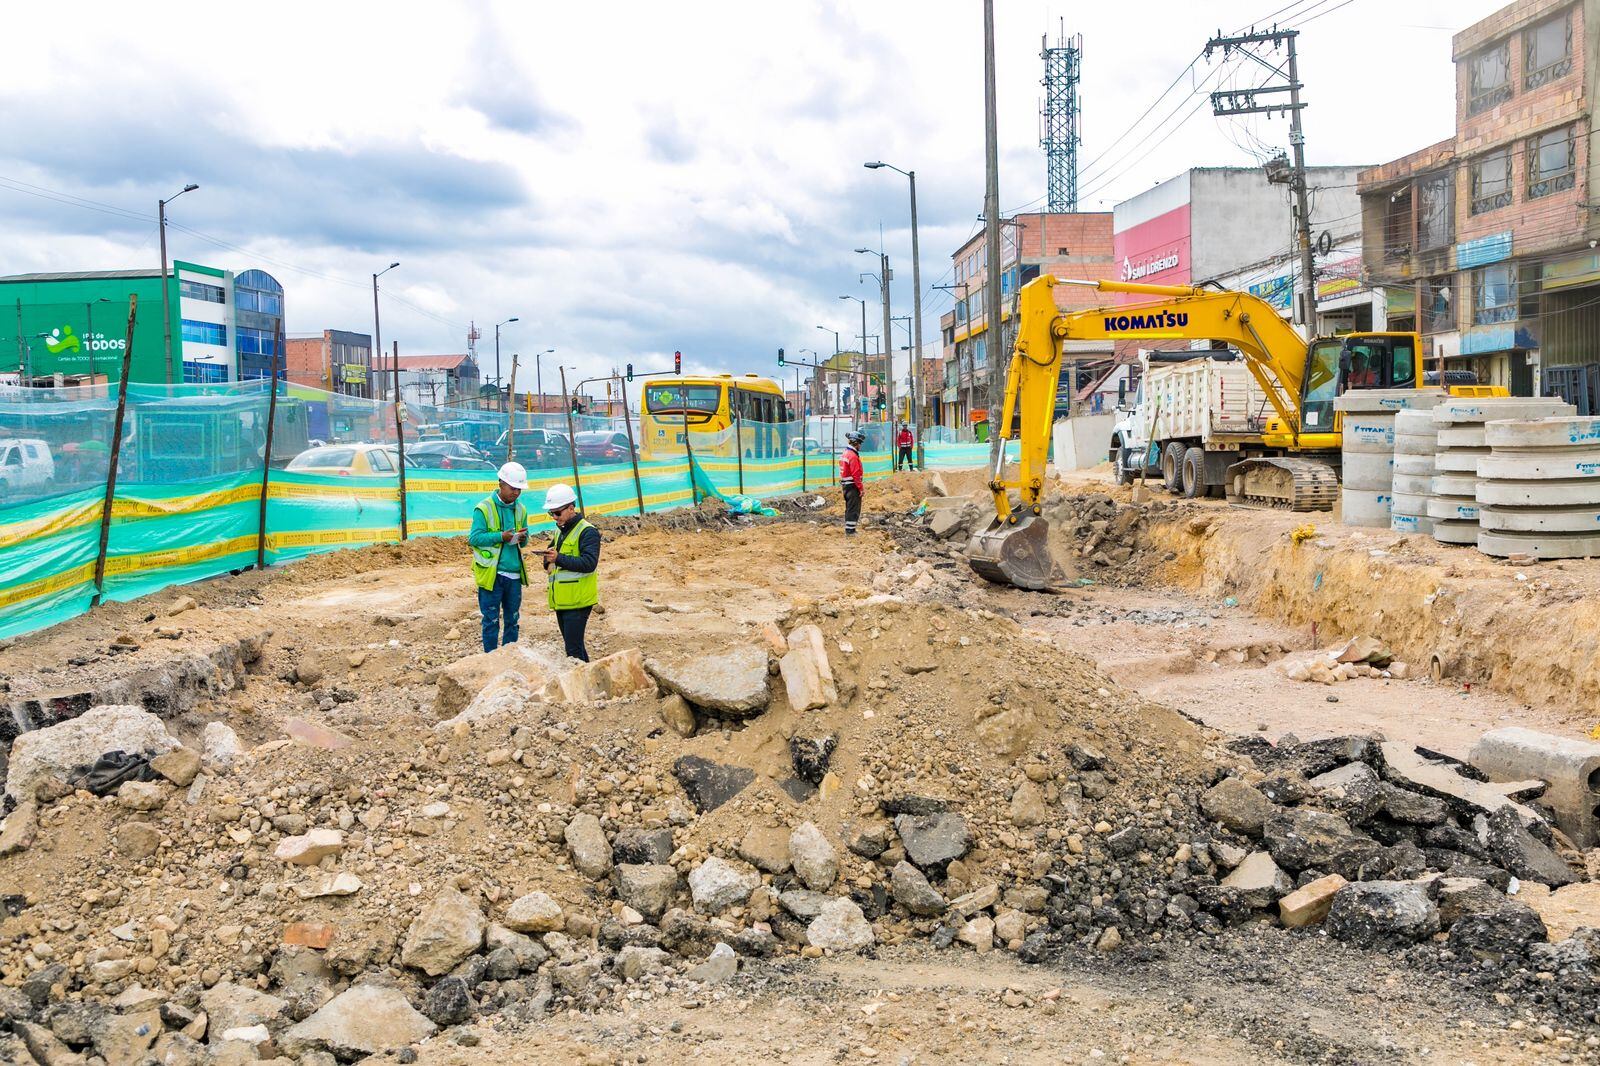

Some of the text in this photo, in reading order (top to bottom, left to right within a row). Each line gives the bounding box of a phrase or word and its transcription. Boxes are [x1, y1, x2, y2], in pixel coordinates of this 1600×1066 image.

[1132, 265, 1146, 280] SAN
[1146, 254, 1178, 276] LORENZO
[1104, 310, 1188, 331] KOMATSU
[83, 339, 126, 351] TODOS
